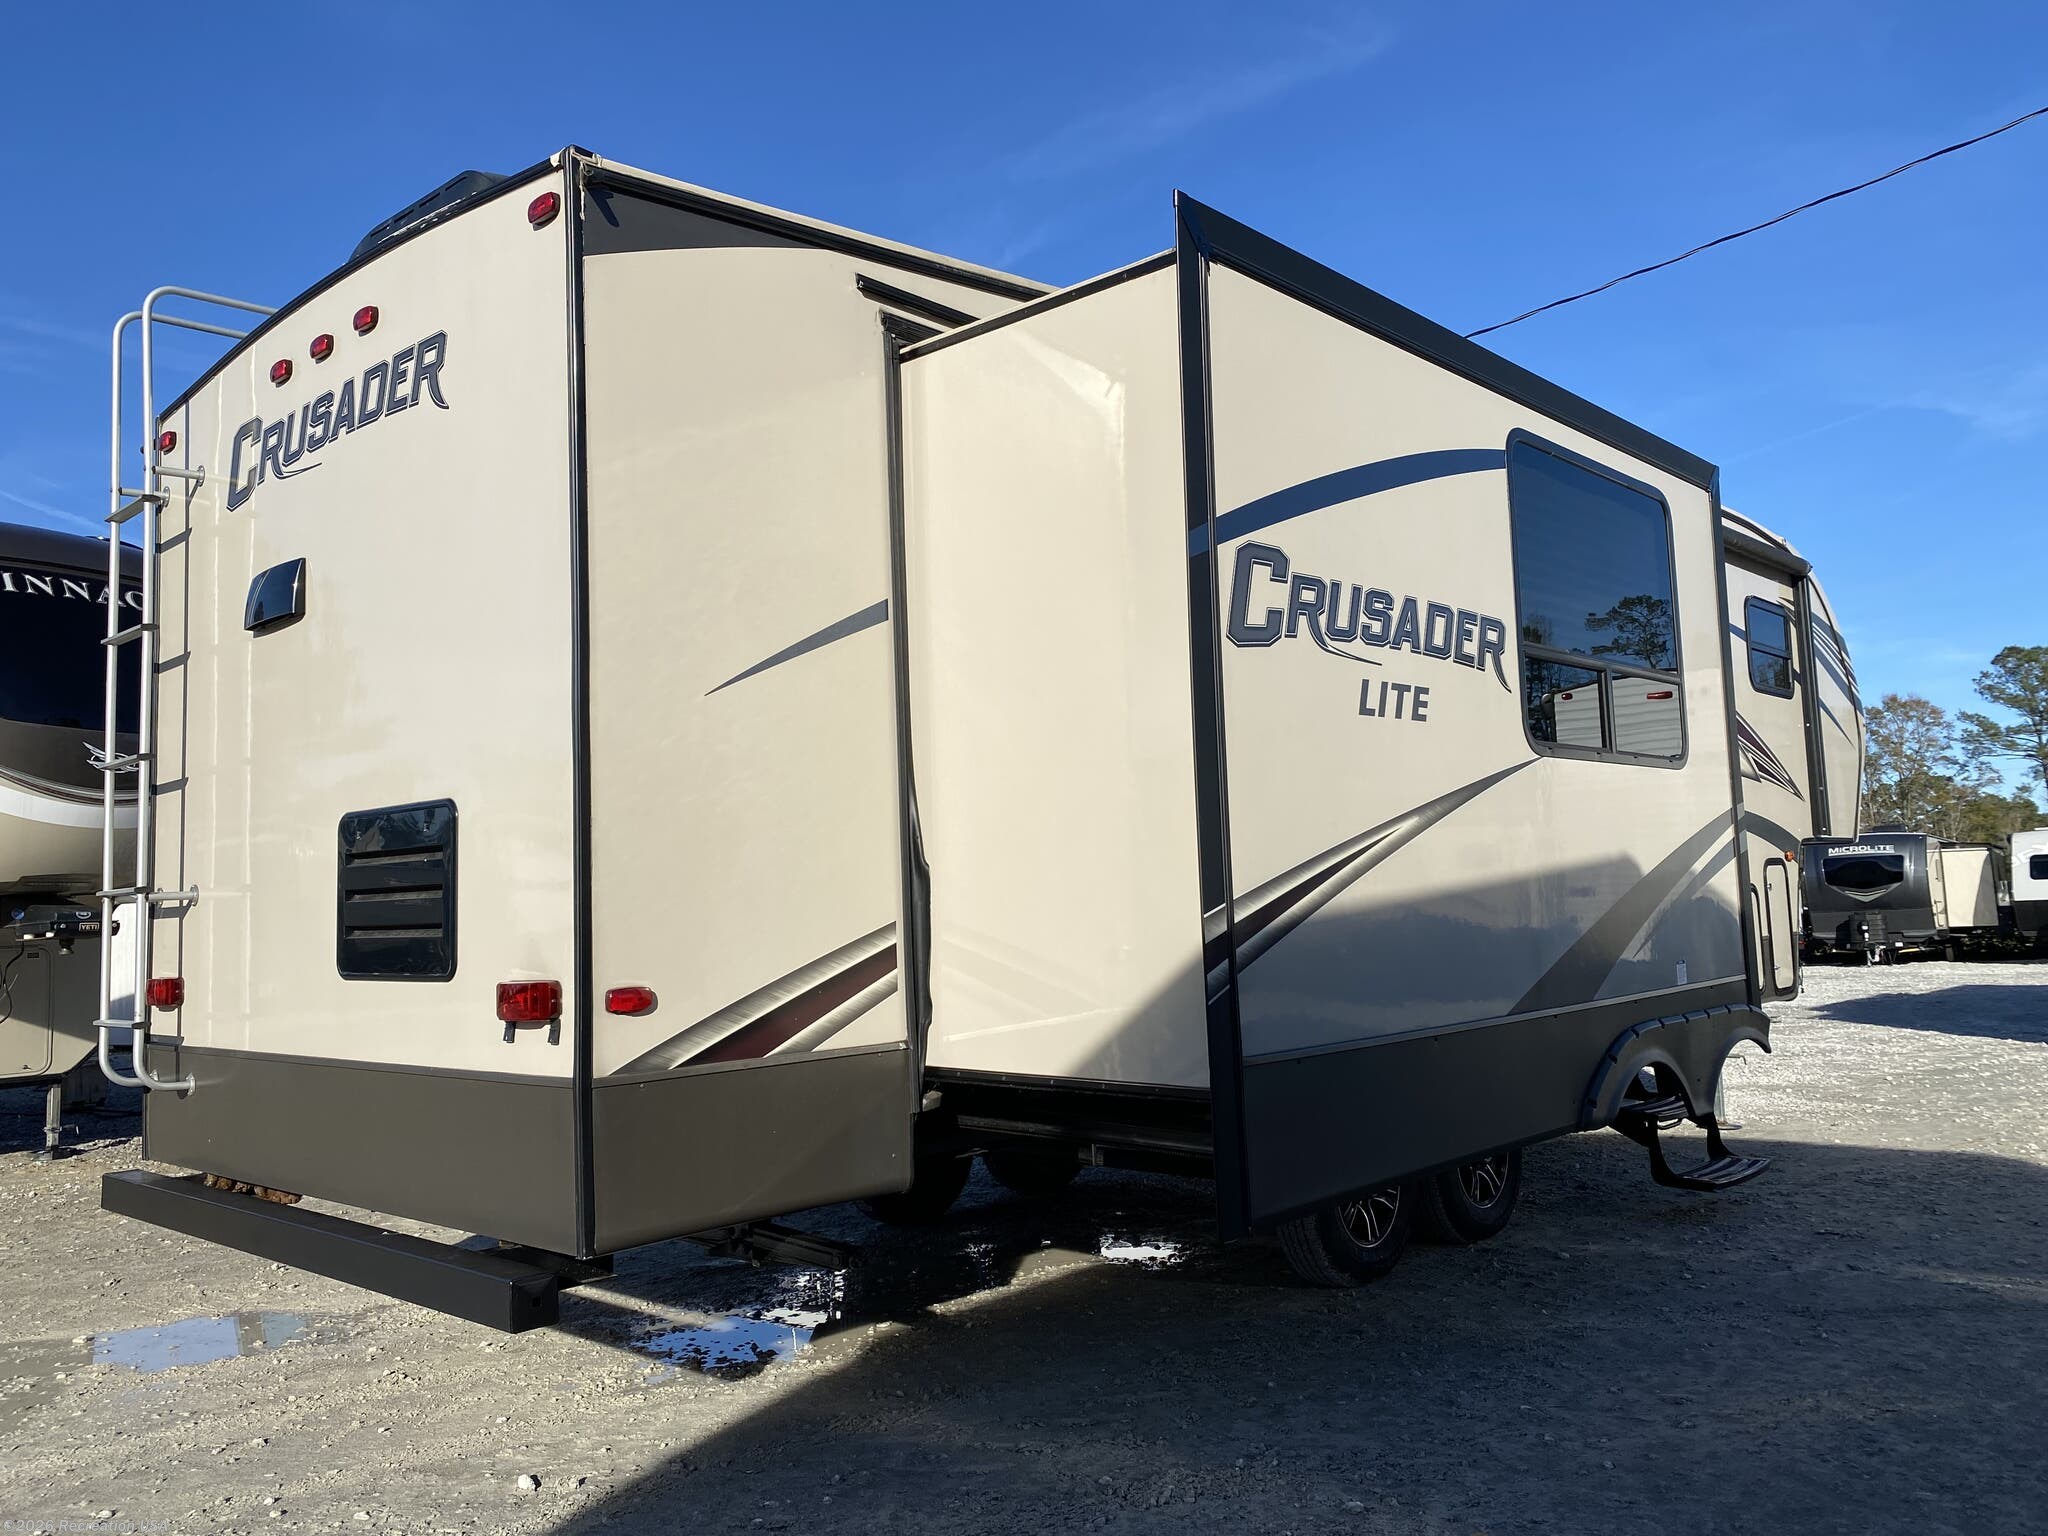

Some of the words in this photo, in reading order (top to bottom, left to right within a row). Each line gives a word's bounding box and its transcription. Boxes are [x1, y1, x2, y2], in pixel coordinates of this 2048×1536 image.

[226, 330, 449, 512] CRUSADER
[1226, 540, 1512, 693] CRUSADER
[1358, 679, 1429, 722] LITE
